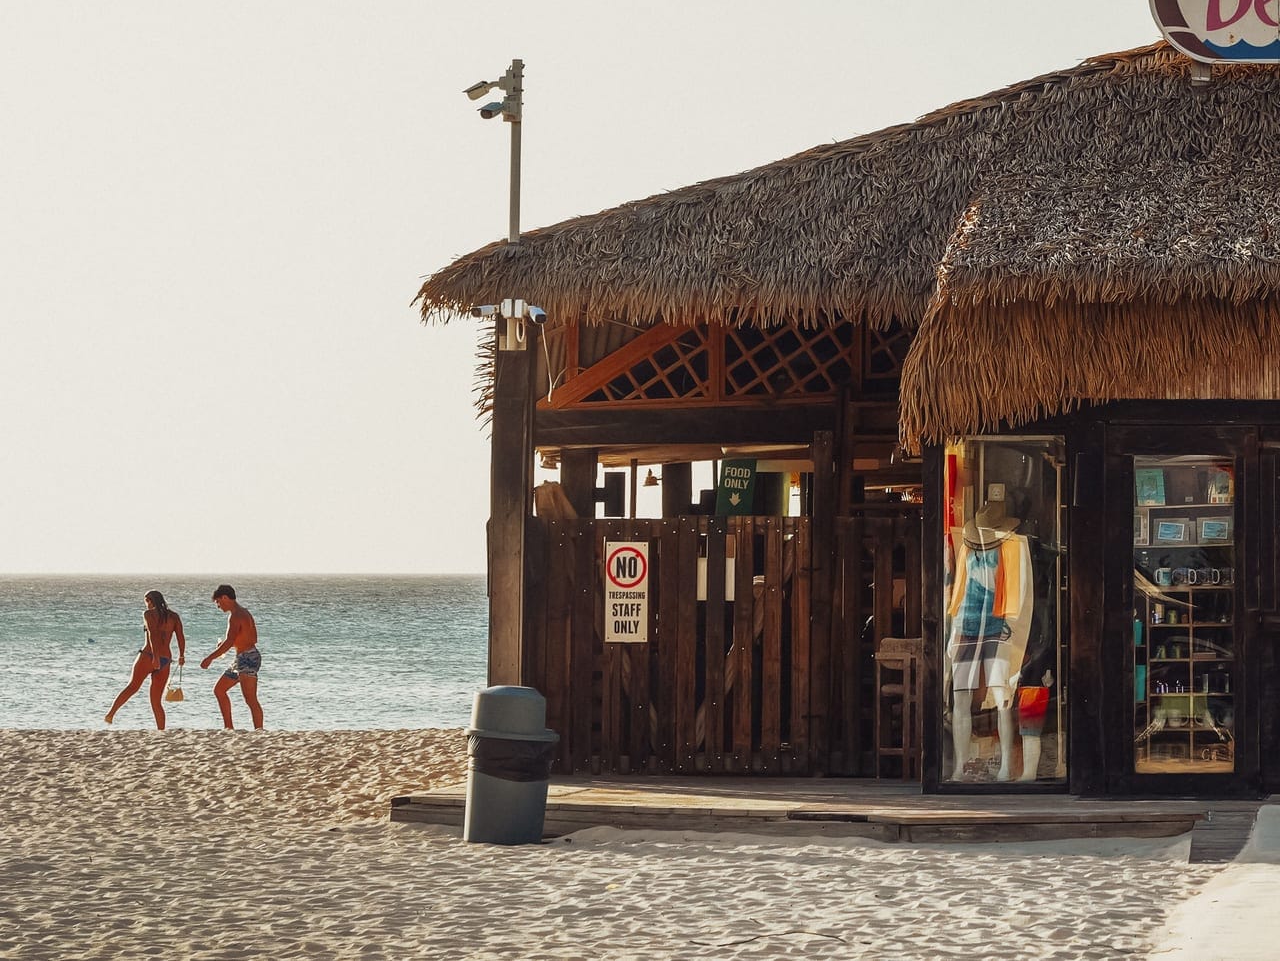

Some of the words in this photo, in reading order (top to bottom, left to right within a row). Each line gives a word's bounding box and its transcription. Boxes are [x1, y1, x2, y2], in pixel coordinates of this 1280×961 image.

[724, 466, 751, 479] FOOD
[724, 478, 750, 489] ONLY
[616, 556, 638, 579] NO
[608, 591, 646, 600] TRESPASSING
[612, 603, 642, 618] STAFF
[614, 620, 640, 635] ONLY
